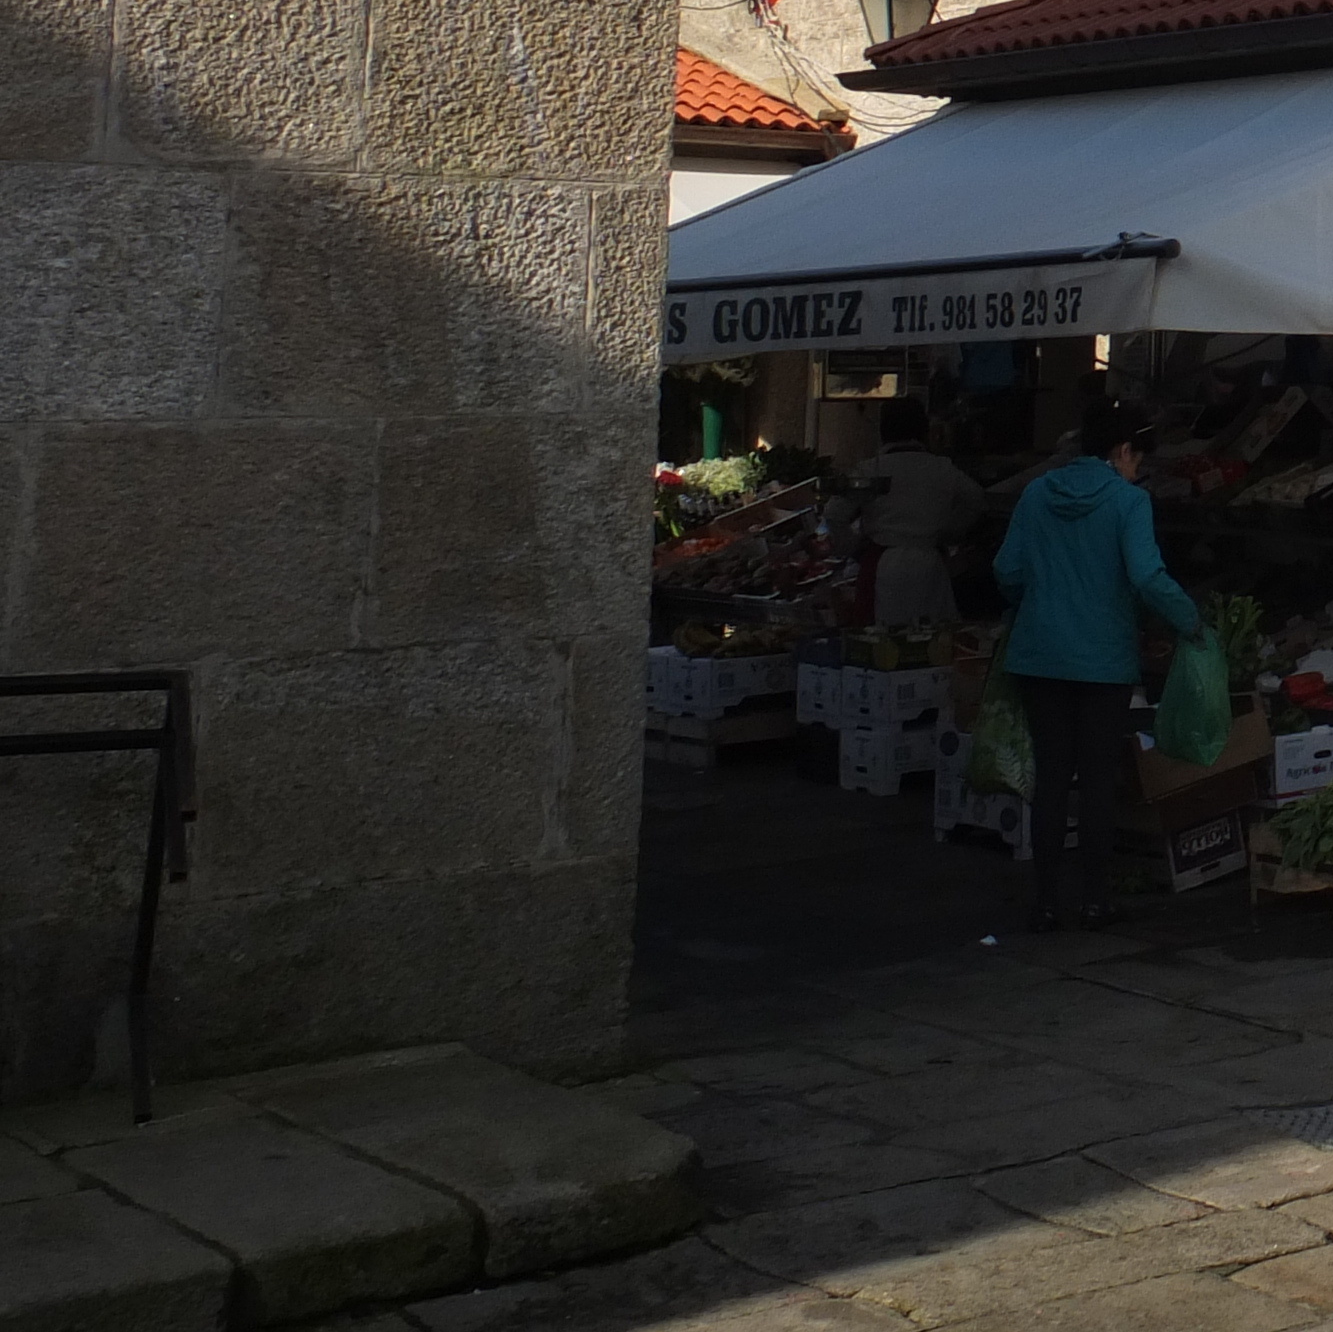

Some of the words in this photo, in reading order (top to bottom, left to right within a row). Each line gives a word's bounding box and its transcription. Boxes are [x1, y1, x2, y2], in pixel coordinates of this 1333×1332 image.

[667, 302, 687, 344] S
[713, 290, 863, 344] GOMEZ
[941, 294, 977, 331] 981
[985, 291, 1015, 329] 58
[1021, 289, 1048, 326] 29
[1054, 286, 1083, 325] 37
